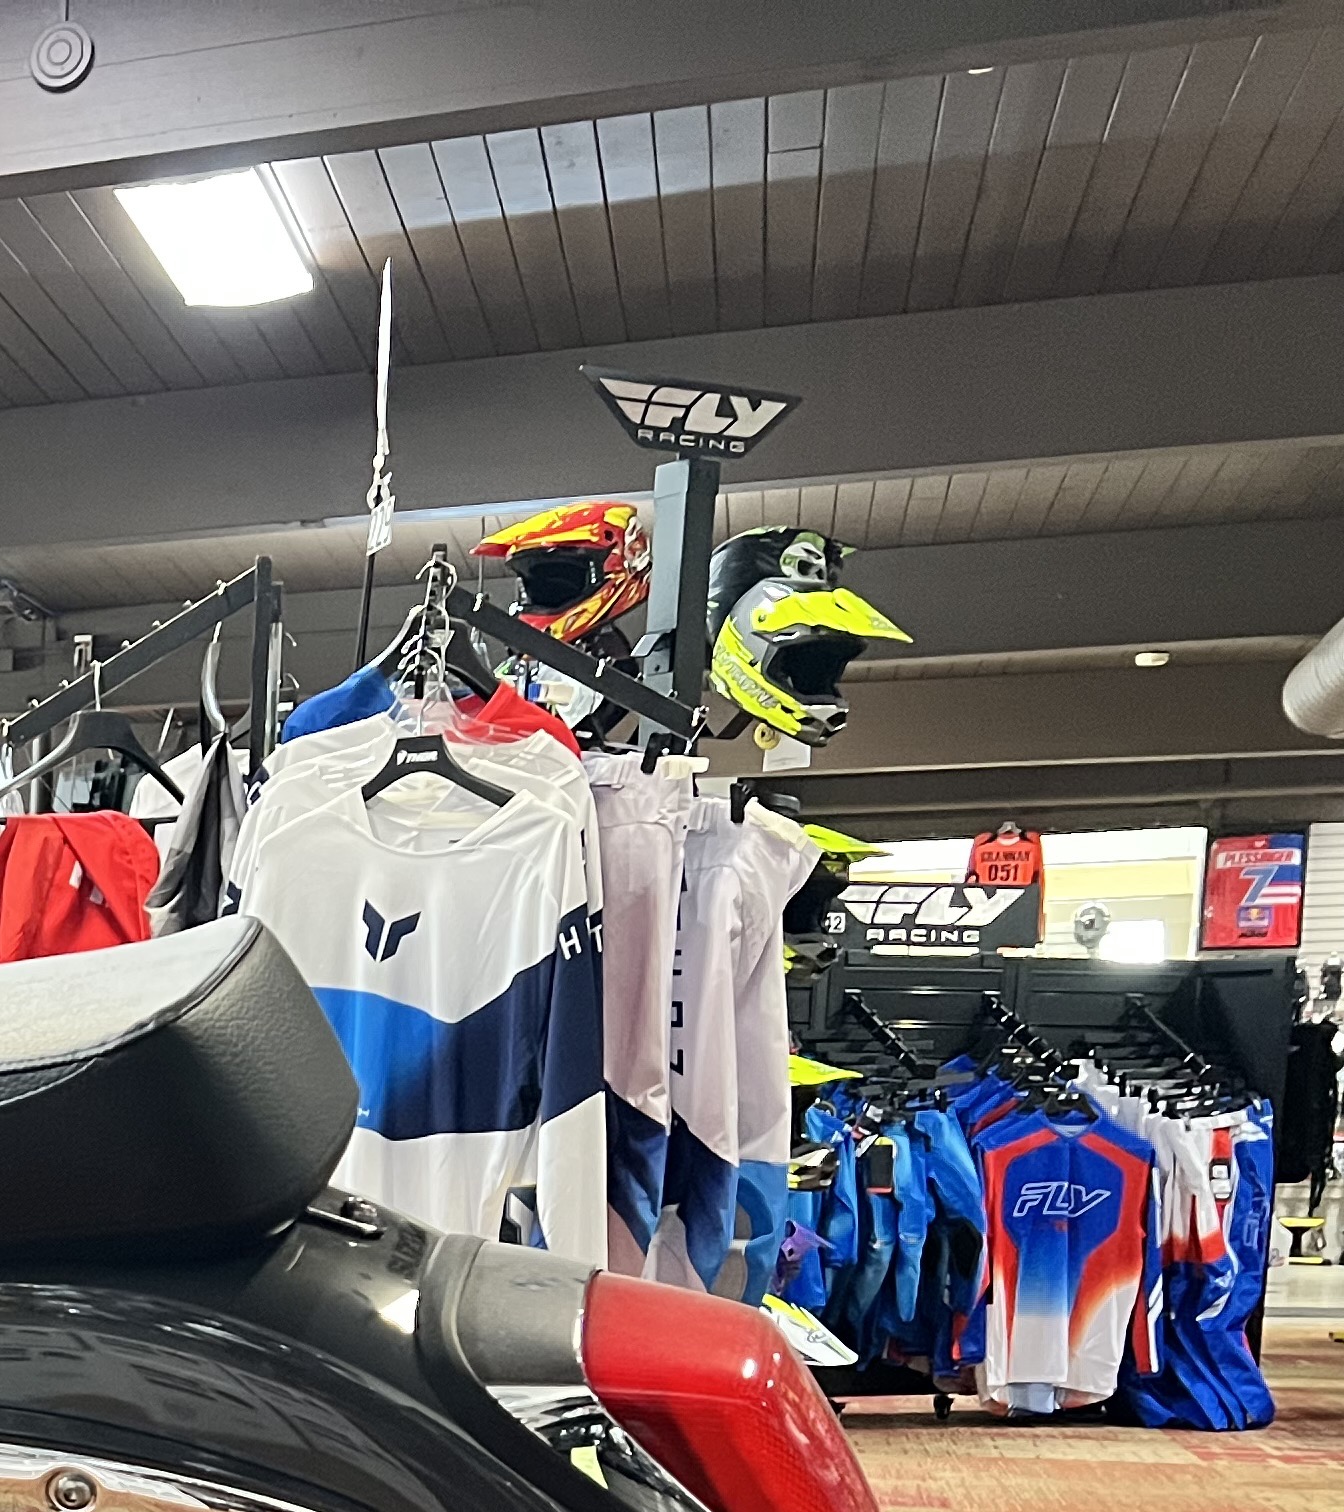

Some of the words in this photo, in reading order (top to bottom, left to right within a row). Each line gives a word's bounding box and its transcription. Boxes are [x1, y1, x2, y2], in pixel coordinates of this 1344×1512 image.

[637, 427, 746, 454] RACING
[1238, 864, 1280, 906] 7
[866, 928, 981, 943] RACING
[1012, 1181, 1112, 1218] FLY
